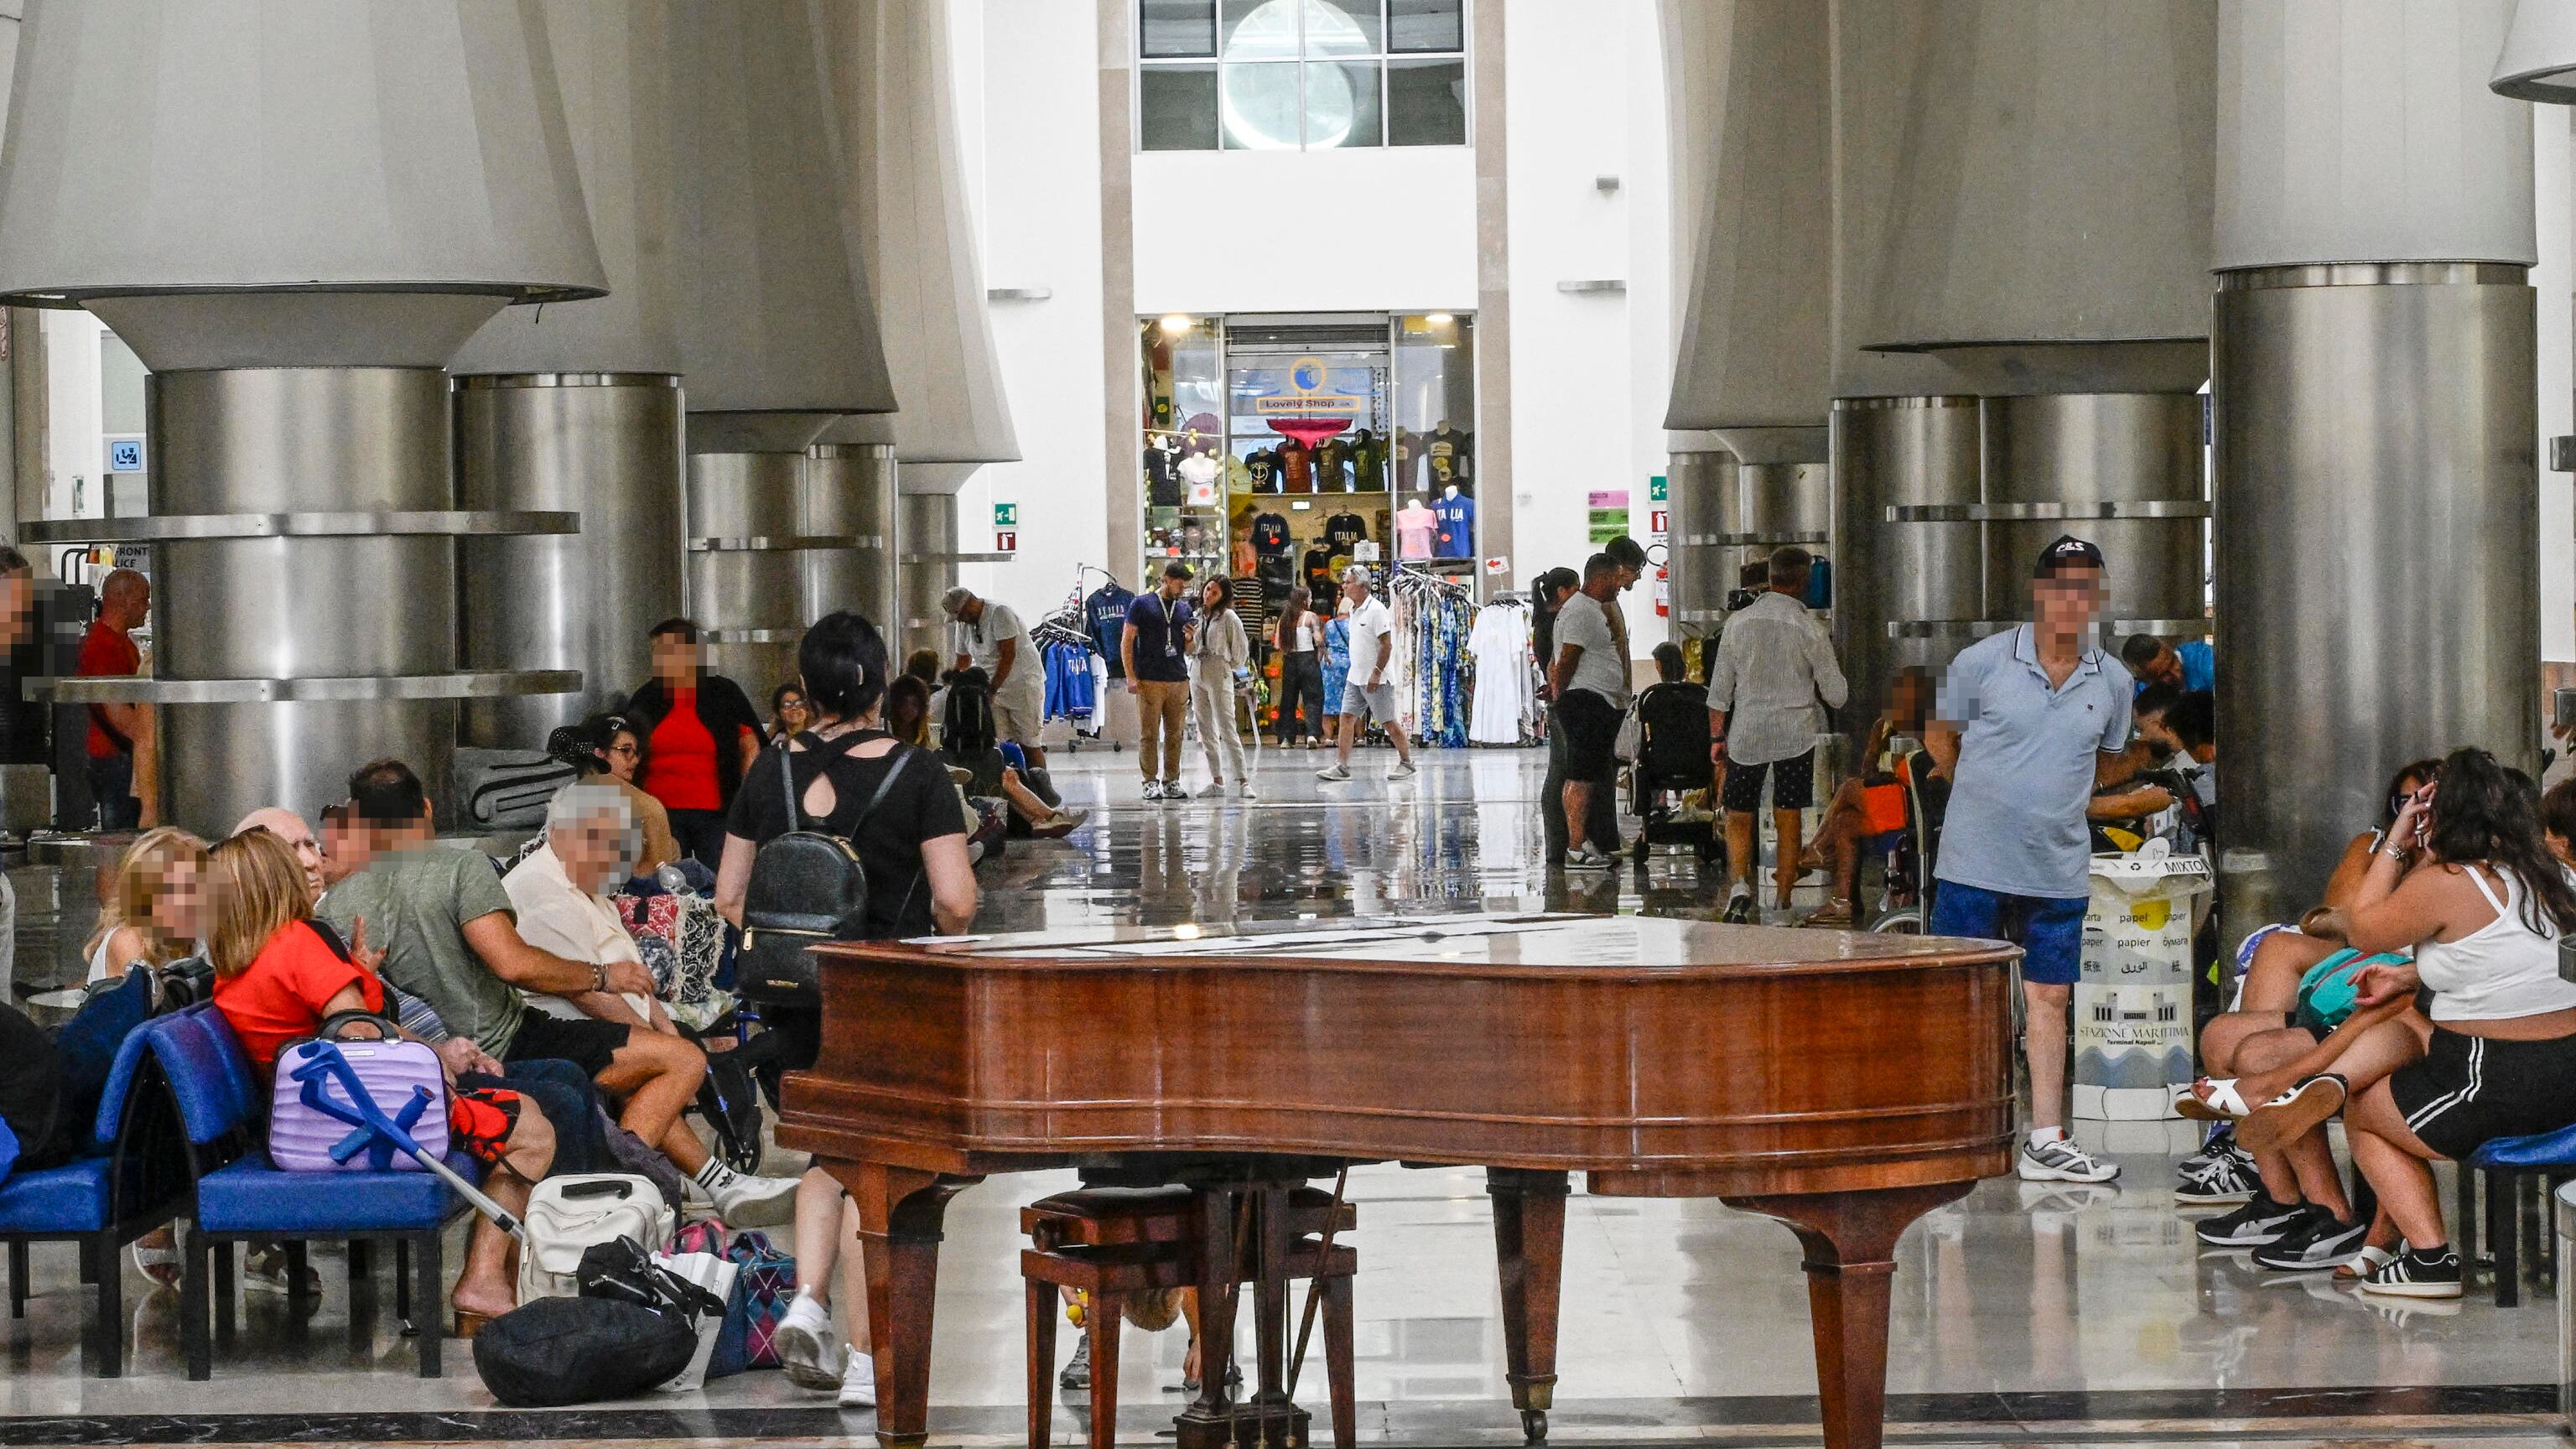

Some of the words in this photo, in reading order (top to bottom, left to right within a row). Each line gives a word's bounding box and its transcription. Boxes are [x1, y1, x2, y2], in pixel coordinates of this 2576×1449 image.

[1265, 400, 1303, 408] Lovely
[1306, 399, 1335, 408] Shop
[1436, 508, 1464, 521] TALIA
[1334, 532, 1358, 542] ITALIA
[115, 558, 136, 568] LICE
[2164, 860, 2204, 873] MIXTO
[2120, 913, 2148, 924] papel
[2082, 938, 2103, 948] paper
[2117, 938, 2151, 948] papier
[2080, 1026, 2126, 1038] STAZIONE
[2132, 1026, 2189, 1038] MARITTIMA
